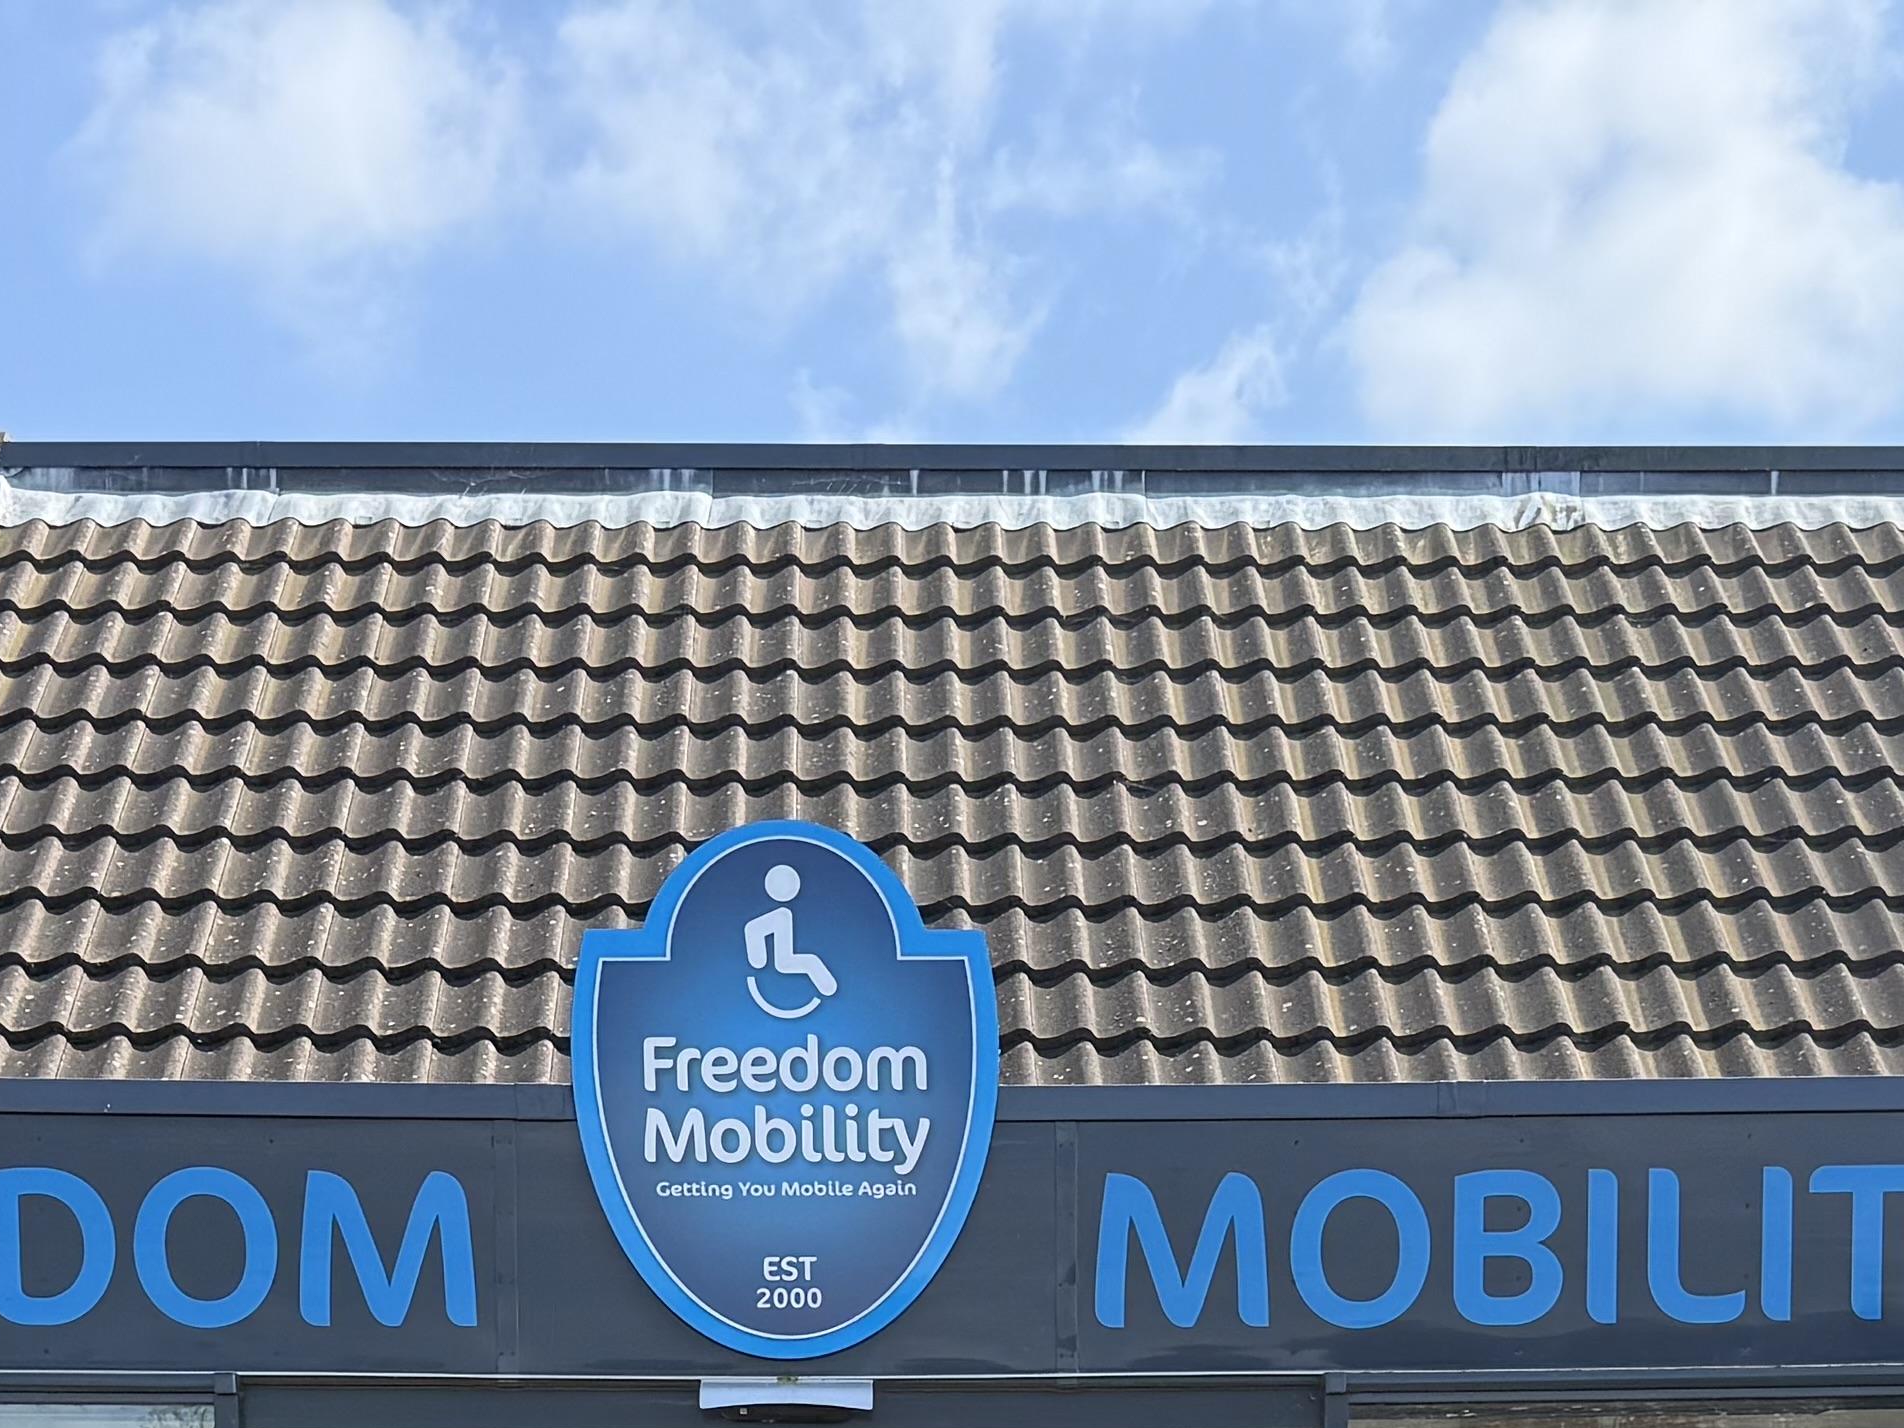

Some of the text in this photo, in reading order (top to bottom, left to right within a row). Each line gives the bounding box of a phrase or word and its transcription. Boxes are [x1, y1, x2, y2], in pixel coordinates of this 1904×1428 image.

[643, 1033, 928, 1093] Freedom
[644, 1103, 931, 1175] Mobility
[656, 1179, 917, 1200] Getting You Mobile Again
[763, 1256, 818, 1282] EST
[756, 1287, 822, 1309] 2000
